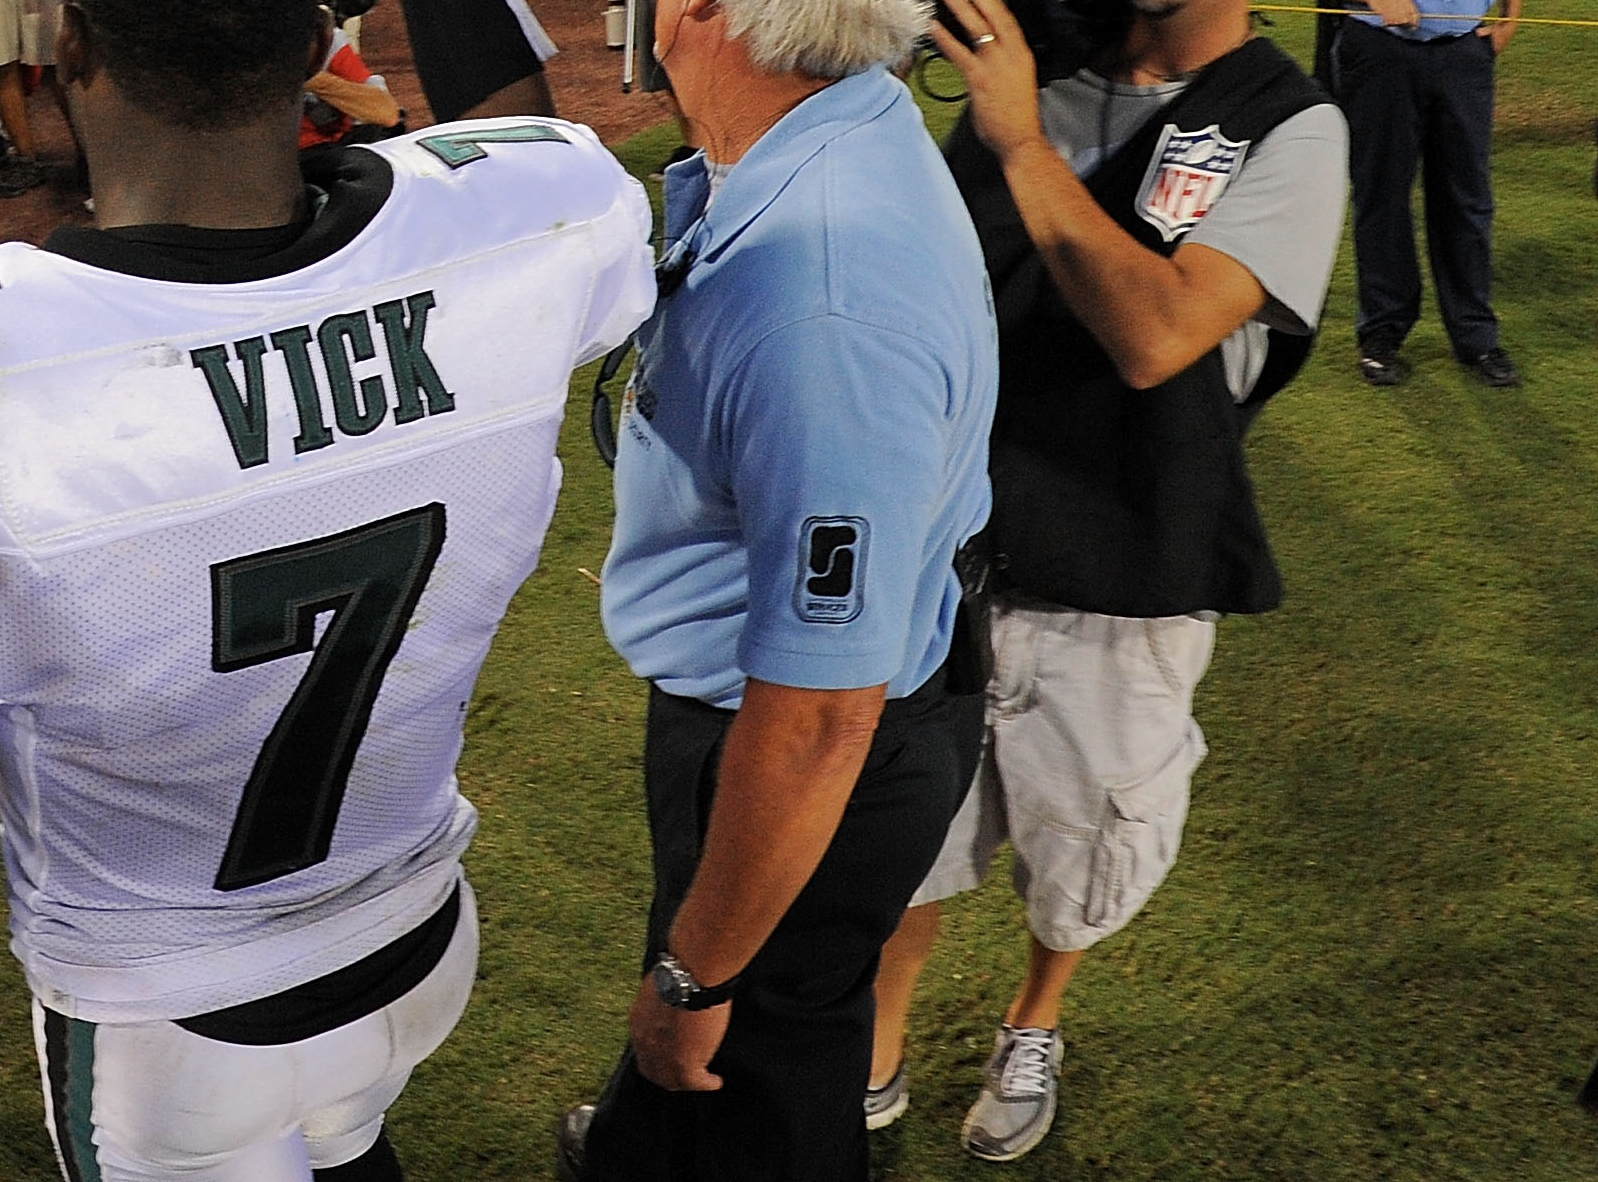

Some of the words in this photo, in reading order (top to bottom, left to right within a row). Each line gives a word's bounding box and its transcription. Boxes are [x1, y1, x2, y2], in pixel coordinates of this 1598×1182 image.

[1146, 167, 1227, 222] NFL
[190, 289, 456, 470] VICK
[211, 502, 446, 891] 7
